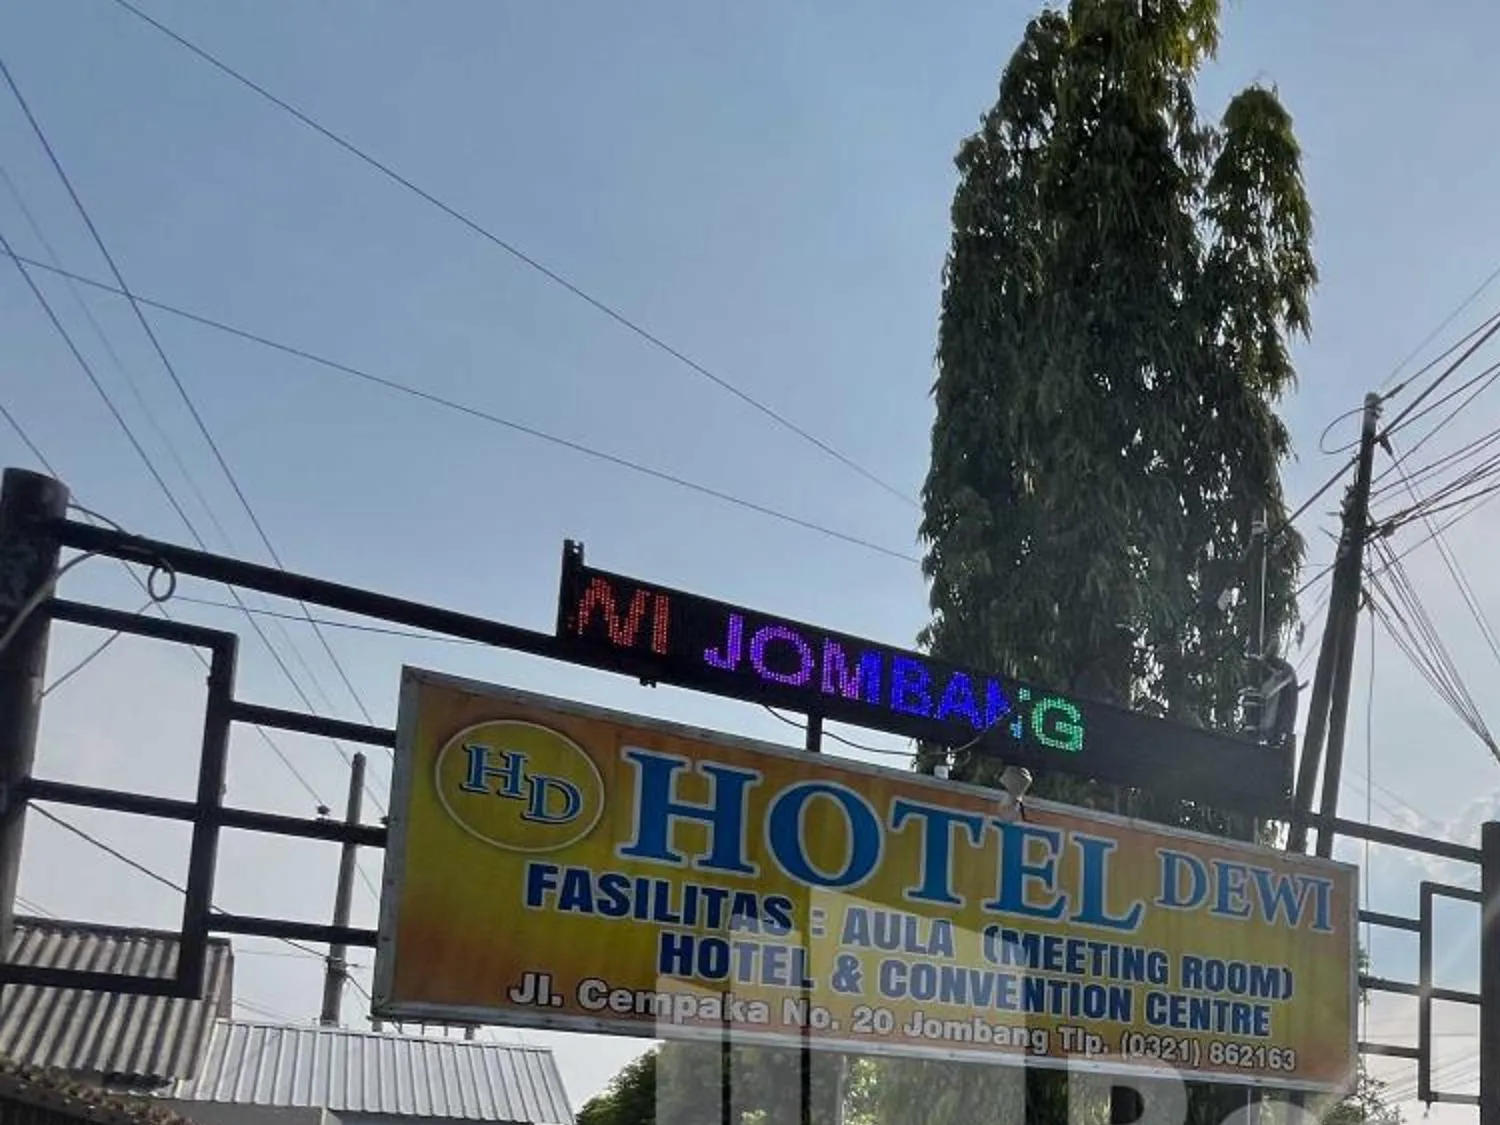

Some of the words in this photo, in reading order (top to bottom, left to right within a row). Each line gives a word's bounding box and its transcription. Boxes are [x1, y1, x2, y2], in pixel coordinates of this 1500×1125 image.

[462, 743, 582, 824] HD
[616, 747, 1144, 931] HOTEL
[1156, 848, 1334, 933] DEWI
[525, 861, 795, 937] FASILITAS
[842, 904, 956, 959] AULA
[982, 924, 1169, 986] (MEETING
[1182, 954, 1294, 1001] ROOM)
[657, 930, 815, 990] HOTEL
[830, 953, 868, 996] &
[878, 957, 1133, 1026] CONVENTION
[1145, 989, 1273, 1038] CENTRE
[575, 976, 771, 1026] Cempaka
[782, 999, 840, 1032] No.
[851, 1003, 895, 1036] 20
[902, 1010, 1050, 1056] Jombang
[1058, 1025, 1110, 1057] Tlp.
[1120, 1030, 1201, 1068] (0321)
[1208, 1039, 1298, 1073] 862163
